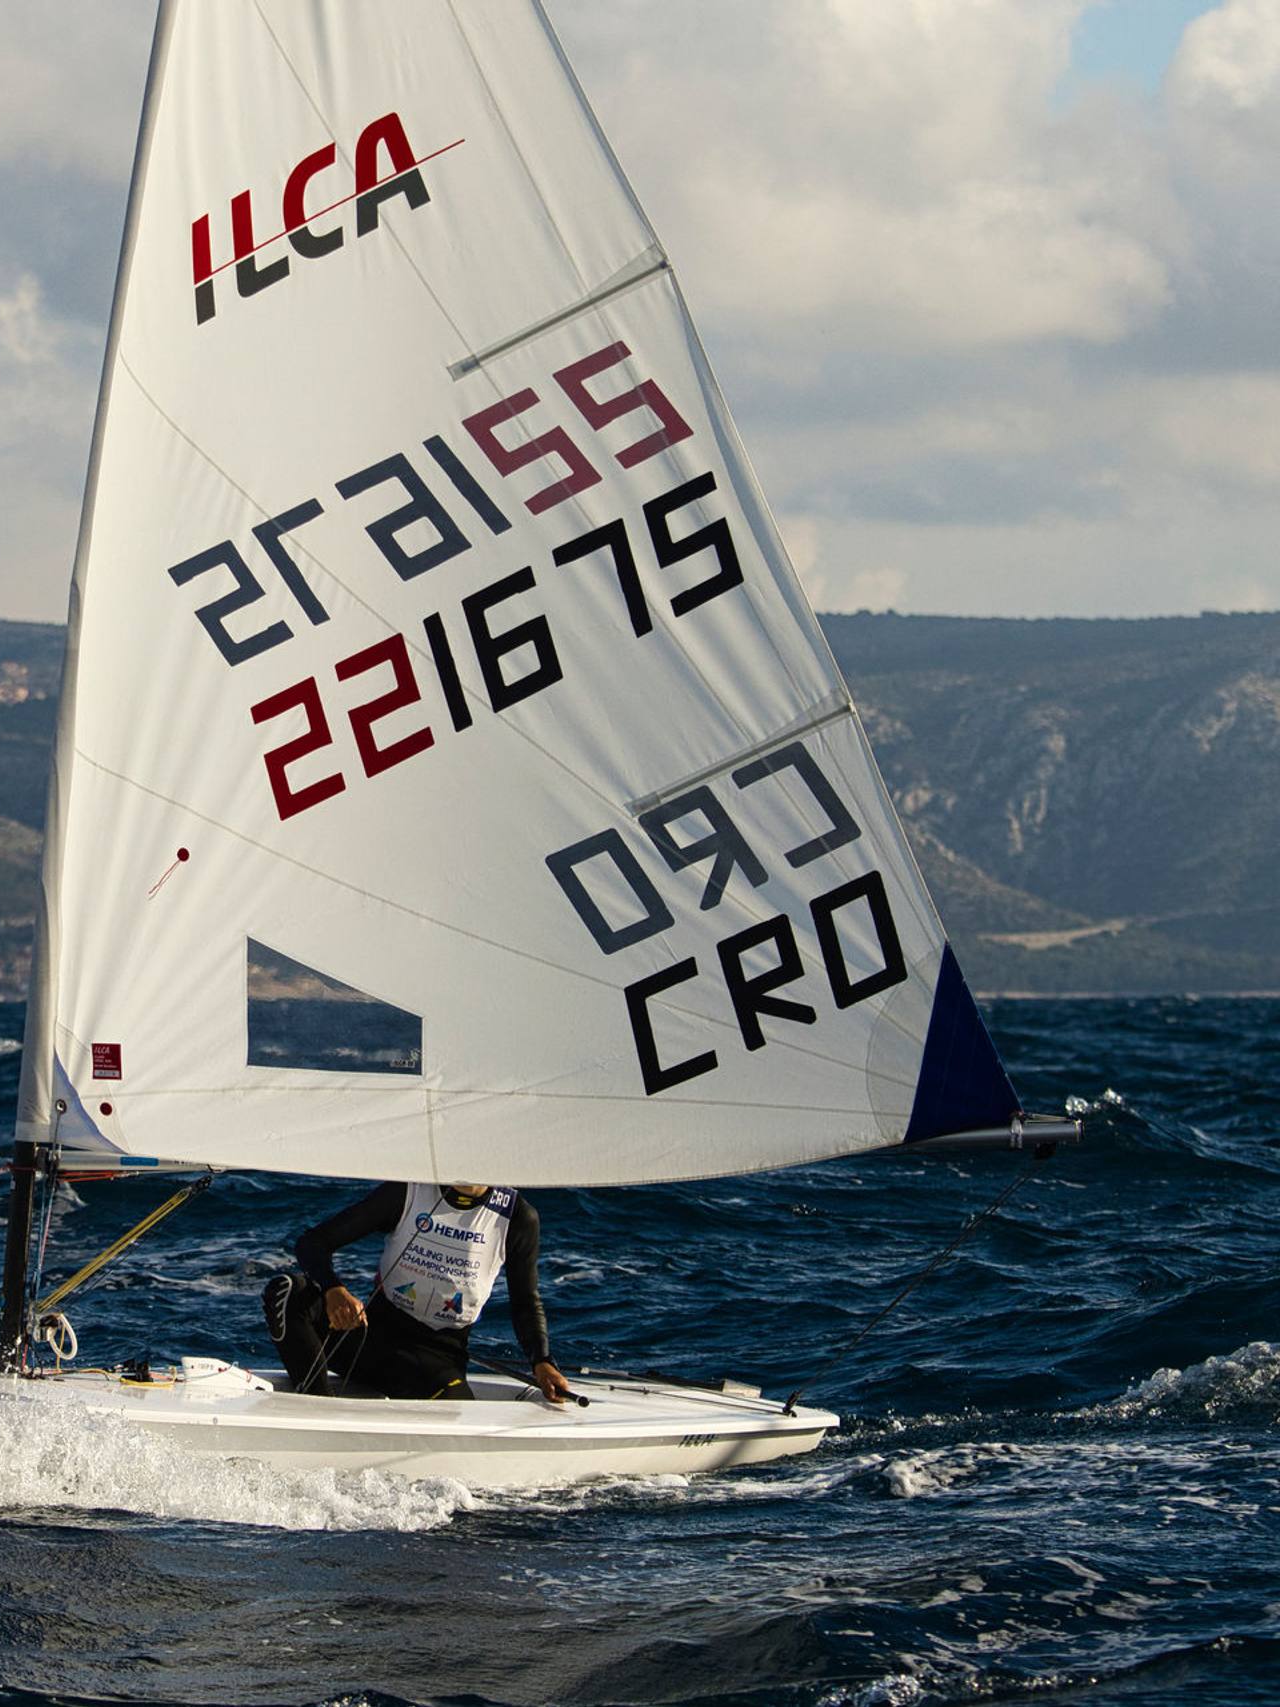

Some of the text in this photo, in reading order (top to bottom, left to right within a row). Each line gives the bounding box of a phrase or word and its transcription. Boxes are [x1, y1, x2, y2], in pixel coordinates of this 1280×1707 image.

[192, 112, 431, 326] ILCA
[250, 471, 744, 821] 221675
[624, 870, 908, 1096] CRO
[489, 1189, 510, 1208] CRO
[434, 1223, 486, 1244] HEMPEL
[402, 1252, 478, 1280] CHAMPIONSHIPS
[407, 1242, 480, 1269] SAILING WORLD
